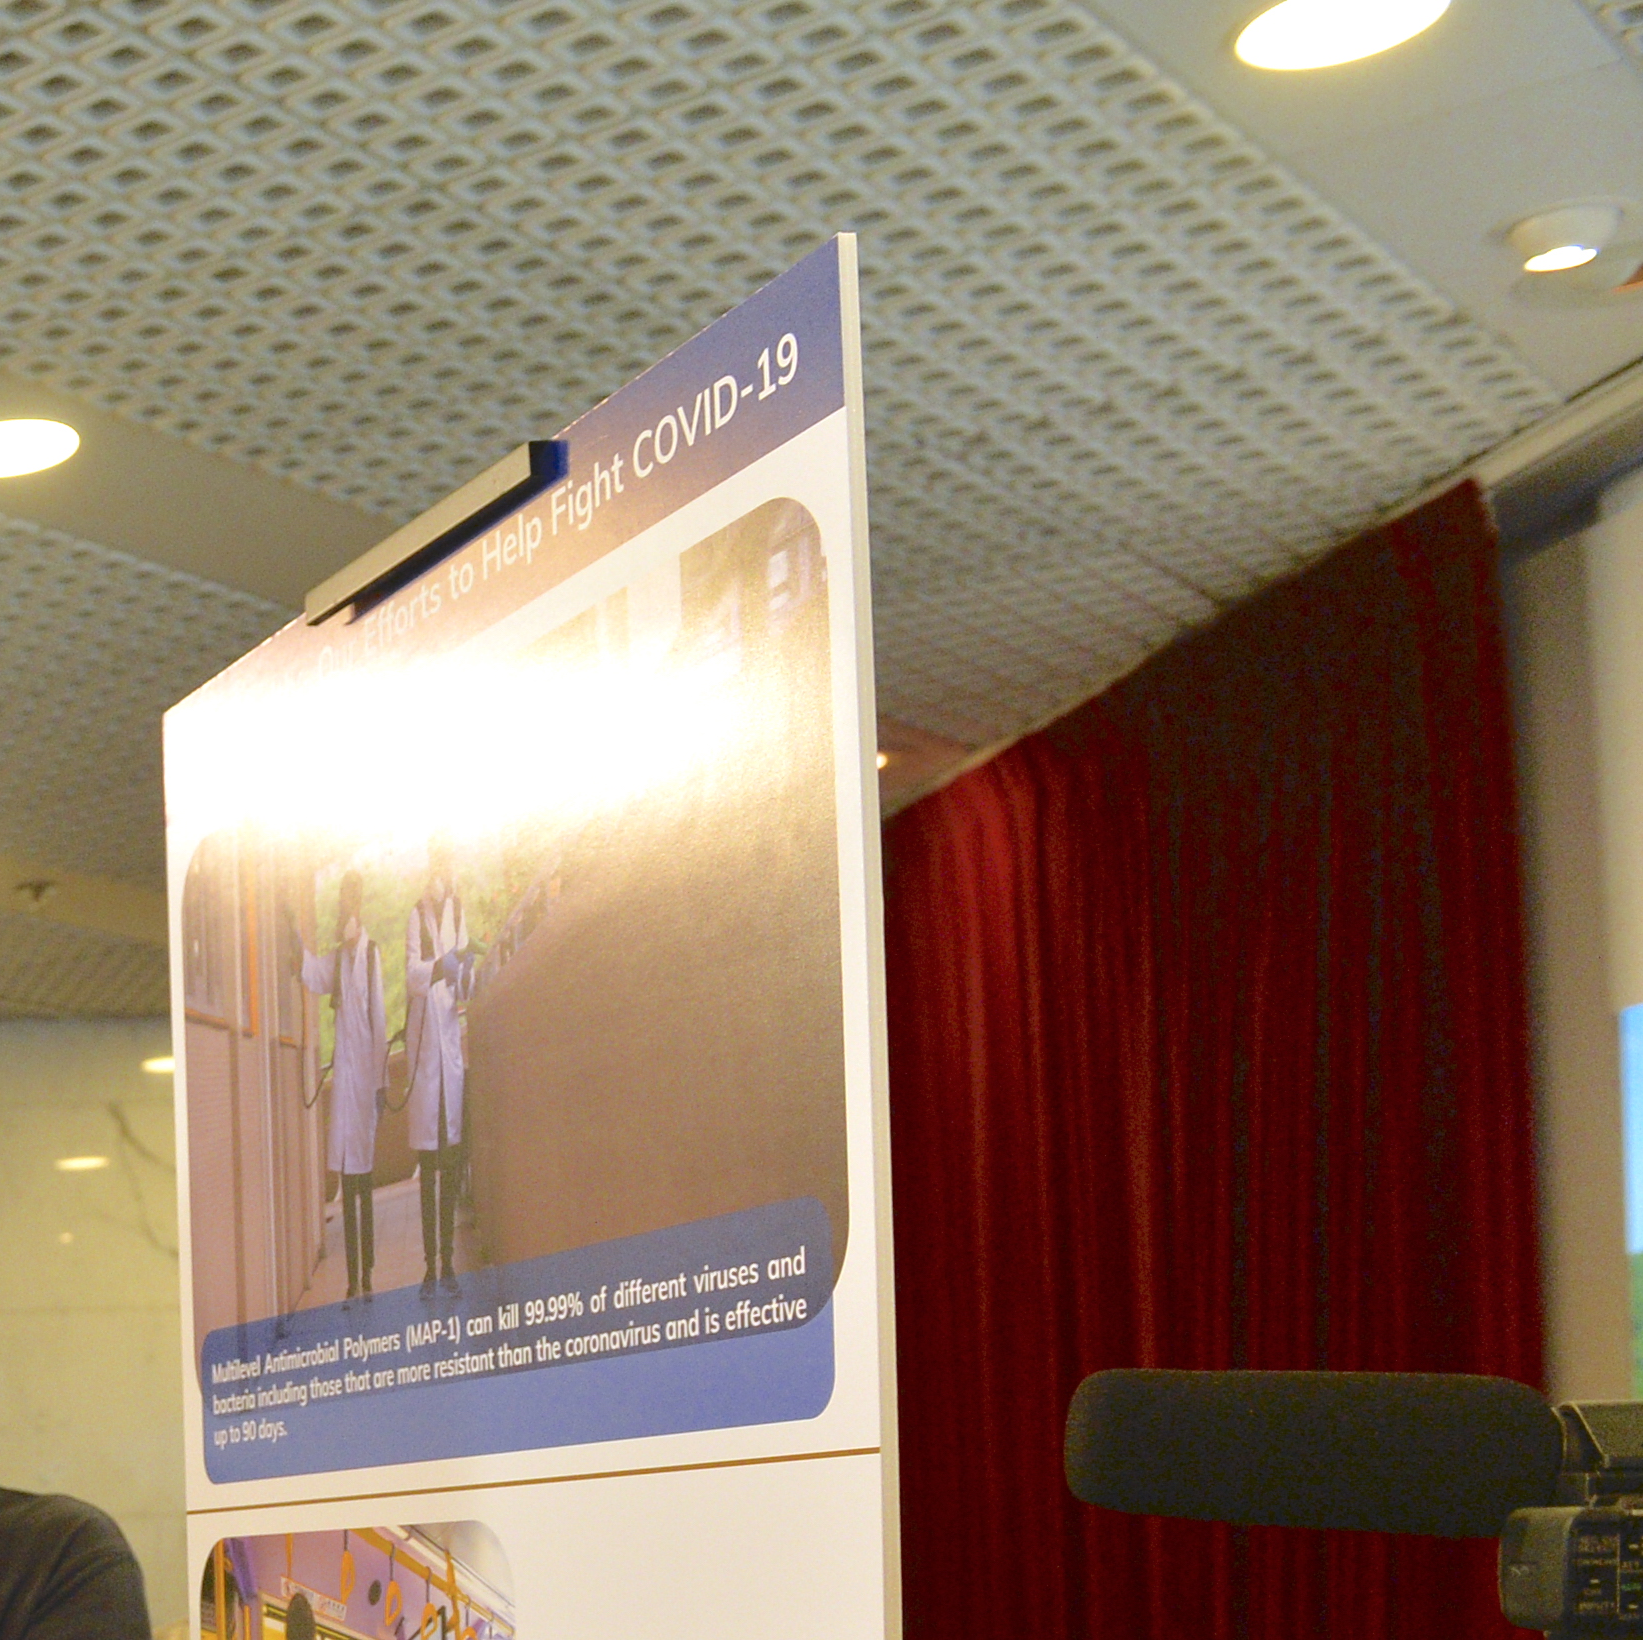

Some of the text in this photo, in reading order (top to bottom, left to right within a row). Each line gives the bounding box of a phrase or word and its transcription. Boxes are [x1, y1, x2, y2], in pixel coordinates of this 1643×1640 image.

[365, 582, 442, 650] Efforts
[449, 562, 475, 600] to
[481, 513, 543, 581] Help
[551, 452, 625, 536] Fight
[632, 333, 798, 478] COVID-19
[212, 1245, 806, 1384] Multilevel Antimicrobial Polymers (MAP-1) can kill 99.99% of different viruses and
[212, 1293, 808, 1416] bacteria including those that are more resistant than the coronavirus and is effective
[213, 1418, 288, 1451] up to 90 days.
